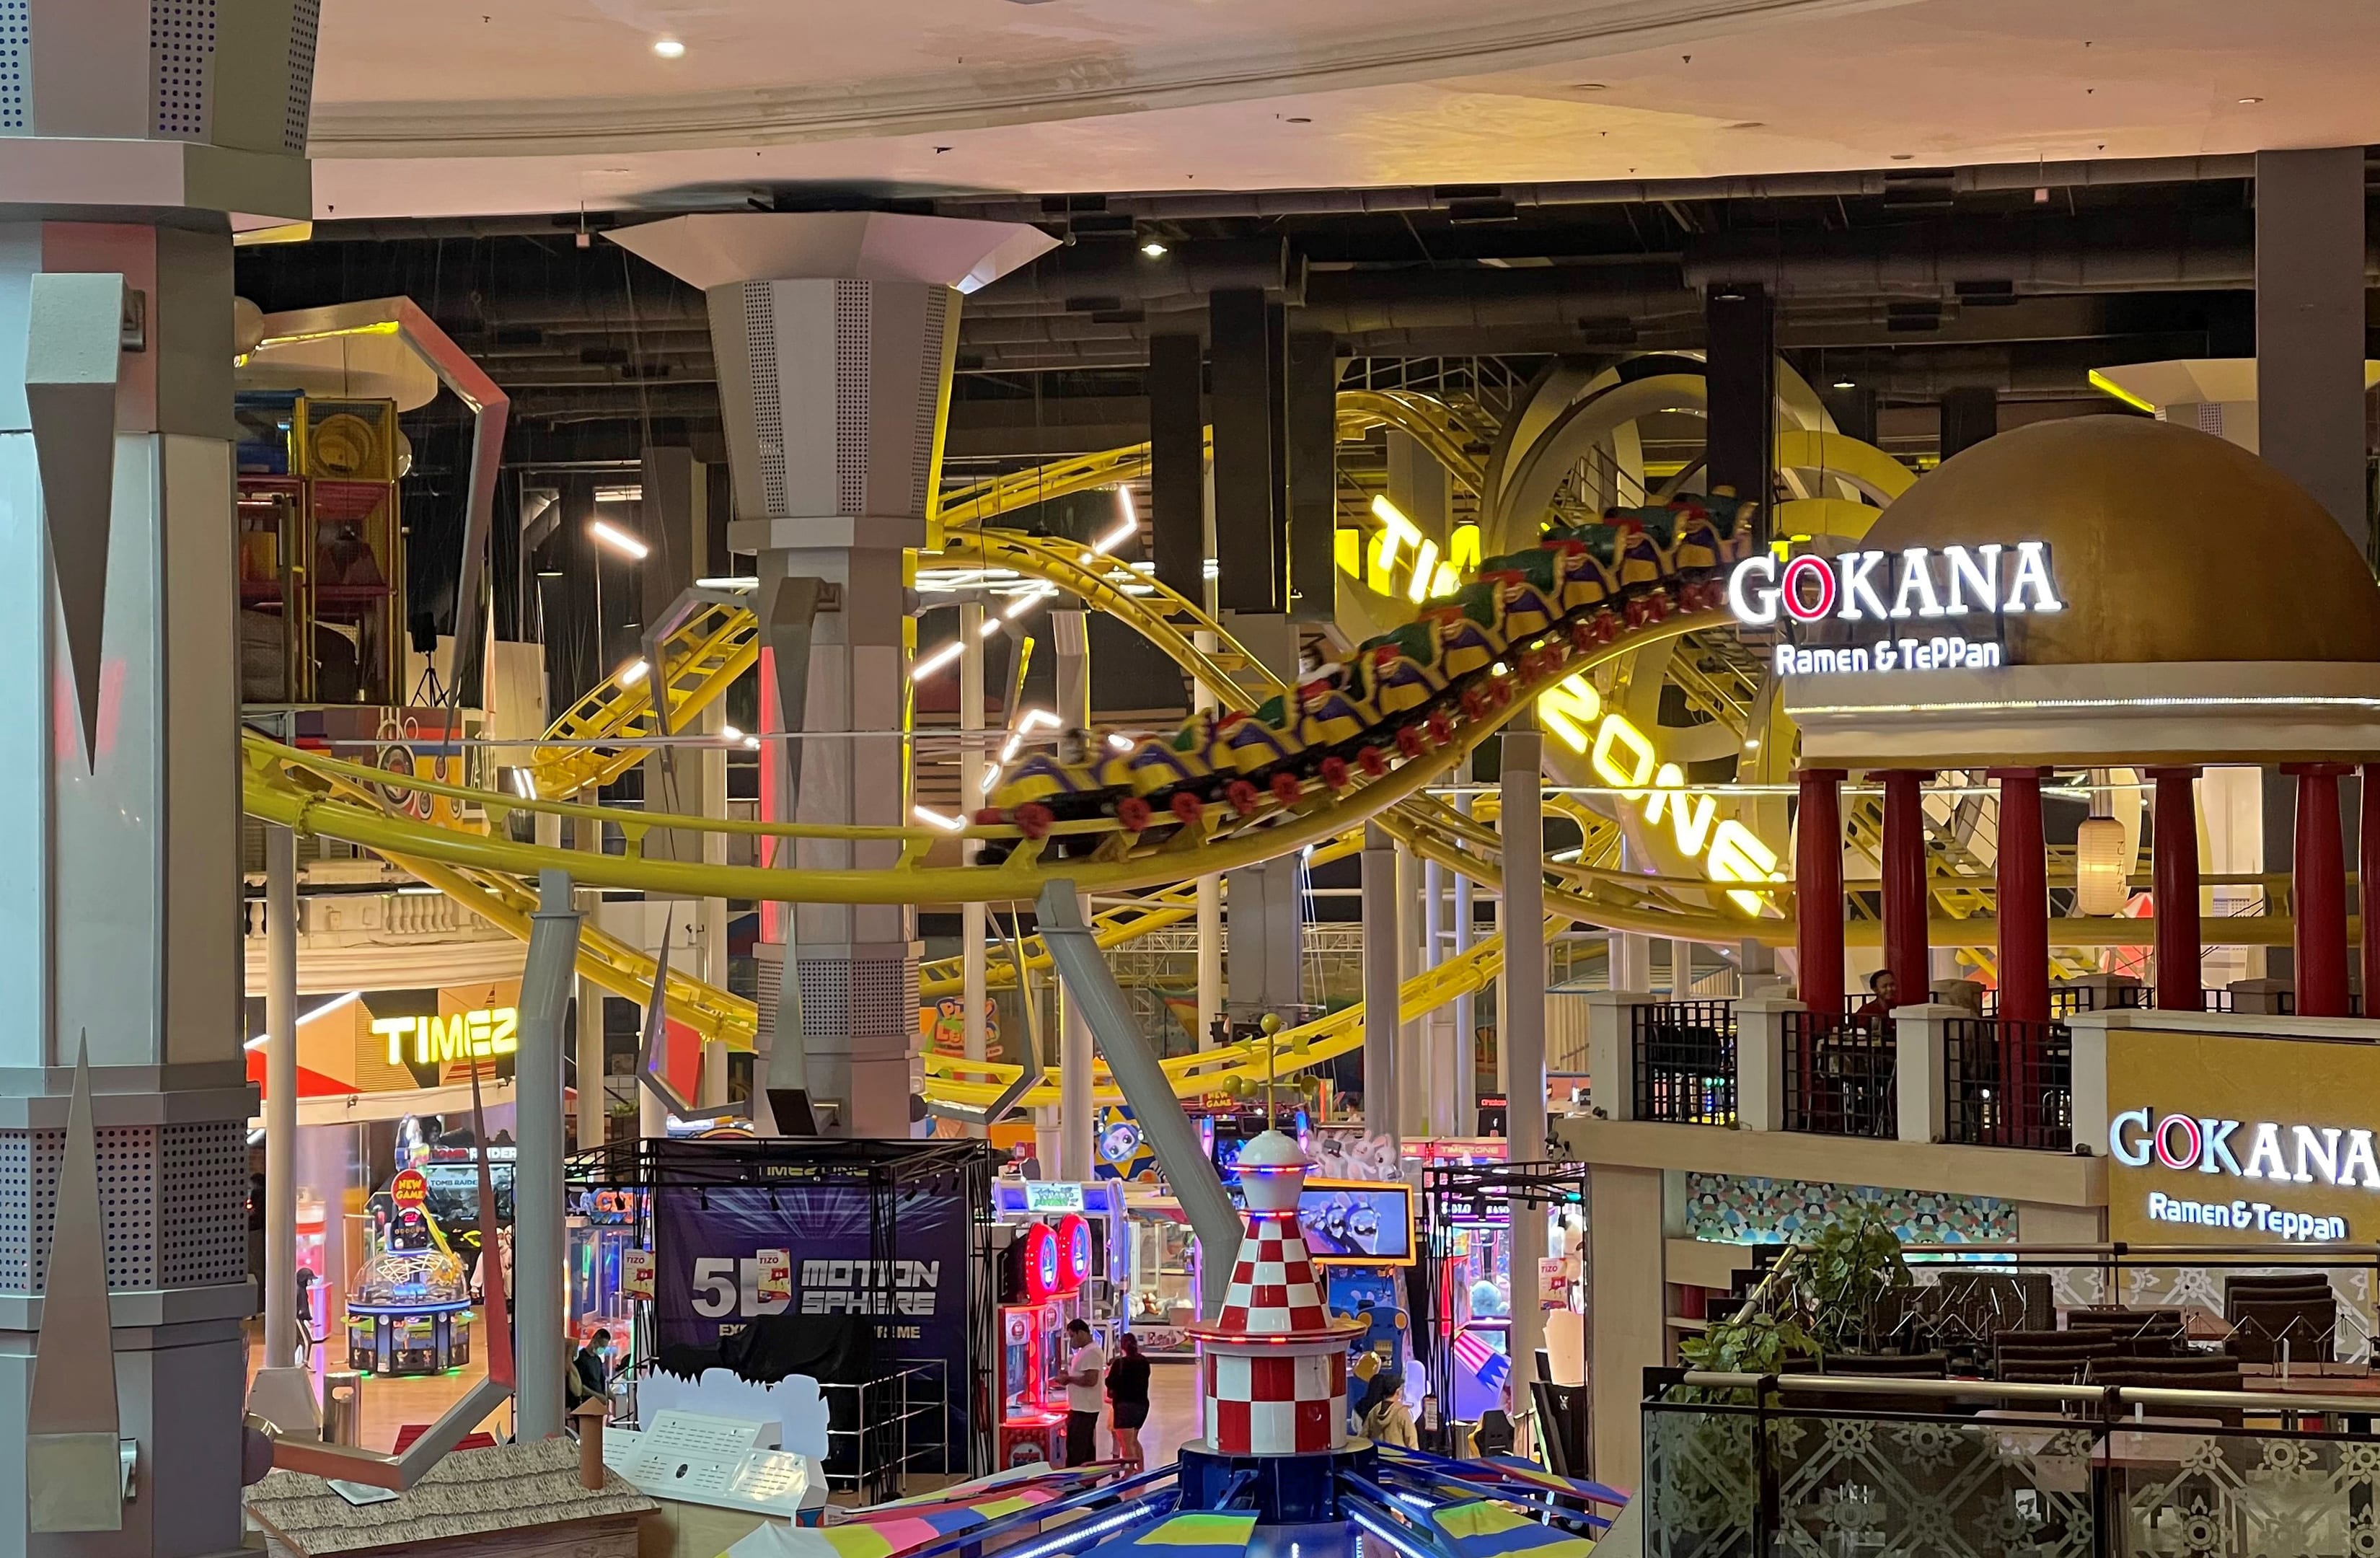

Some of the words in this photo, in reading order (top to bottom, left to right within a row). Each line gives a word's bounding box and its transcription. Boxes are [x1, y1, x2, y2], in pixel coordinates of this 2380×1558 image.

[1729, 542, 2064, 625] GOKANA
[1776, 643, 1869, 676] Ramen
[1874, 639, 1898, 672] &
[1206, 1099, 1232, 1108] GAME
[470, 1147, 517, 1161] RIDER
[1440, 1145, 1499, 1154] TIMEZONE
[2109, 1106, 2380, 1189] GOKANA
[399, 1179, 422, 1189] NEW
[396, 1190, 423, 1200] GAME
[2148, 1192, 2231, 1227] Ramen
[2231, 1200, 2252, 1229] &
[2252, 1202, 2345, 1241] Teppan
[801, 1259, 939, 1288] MOTION
